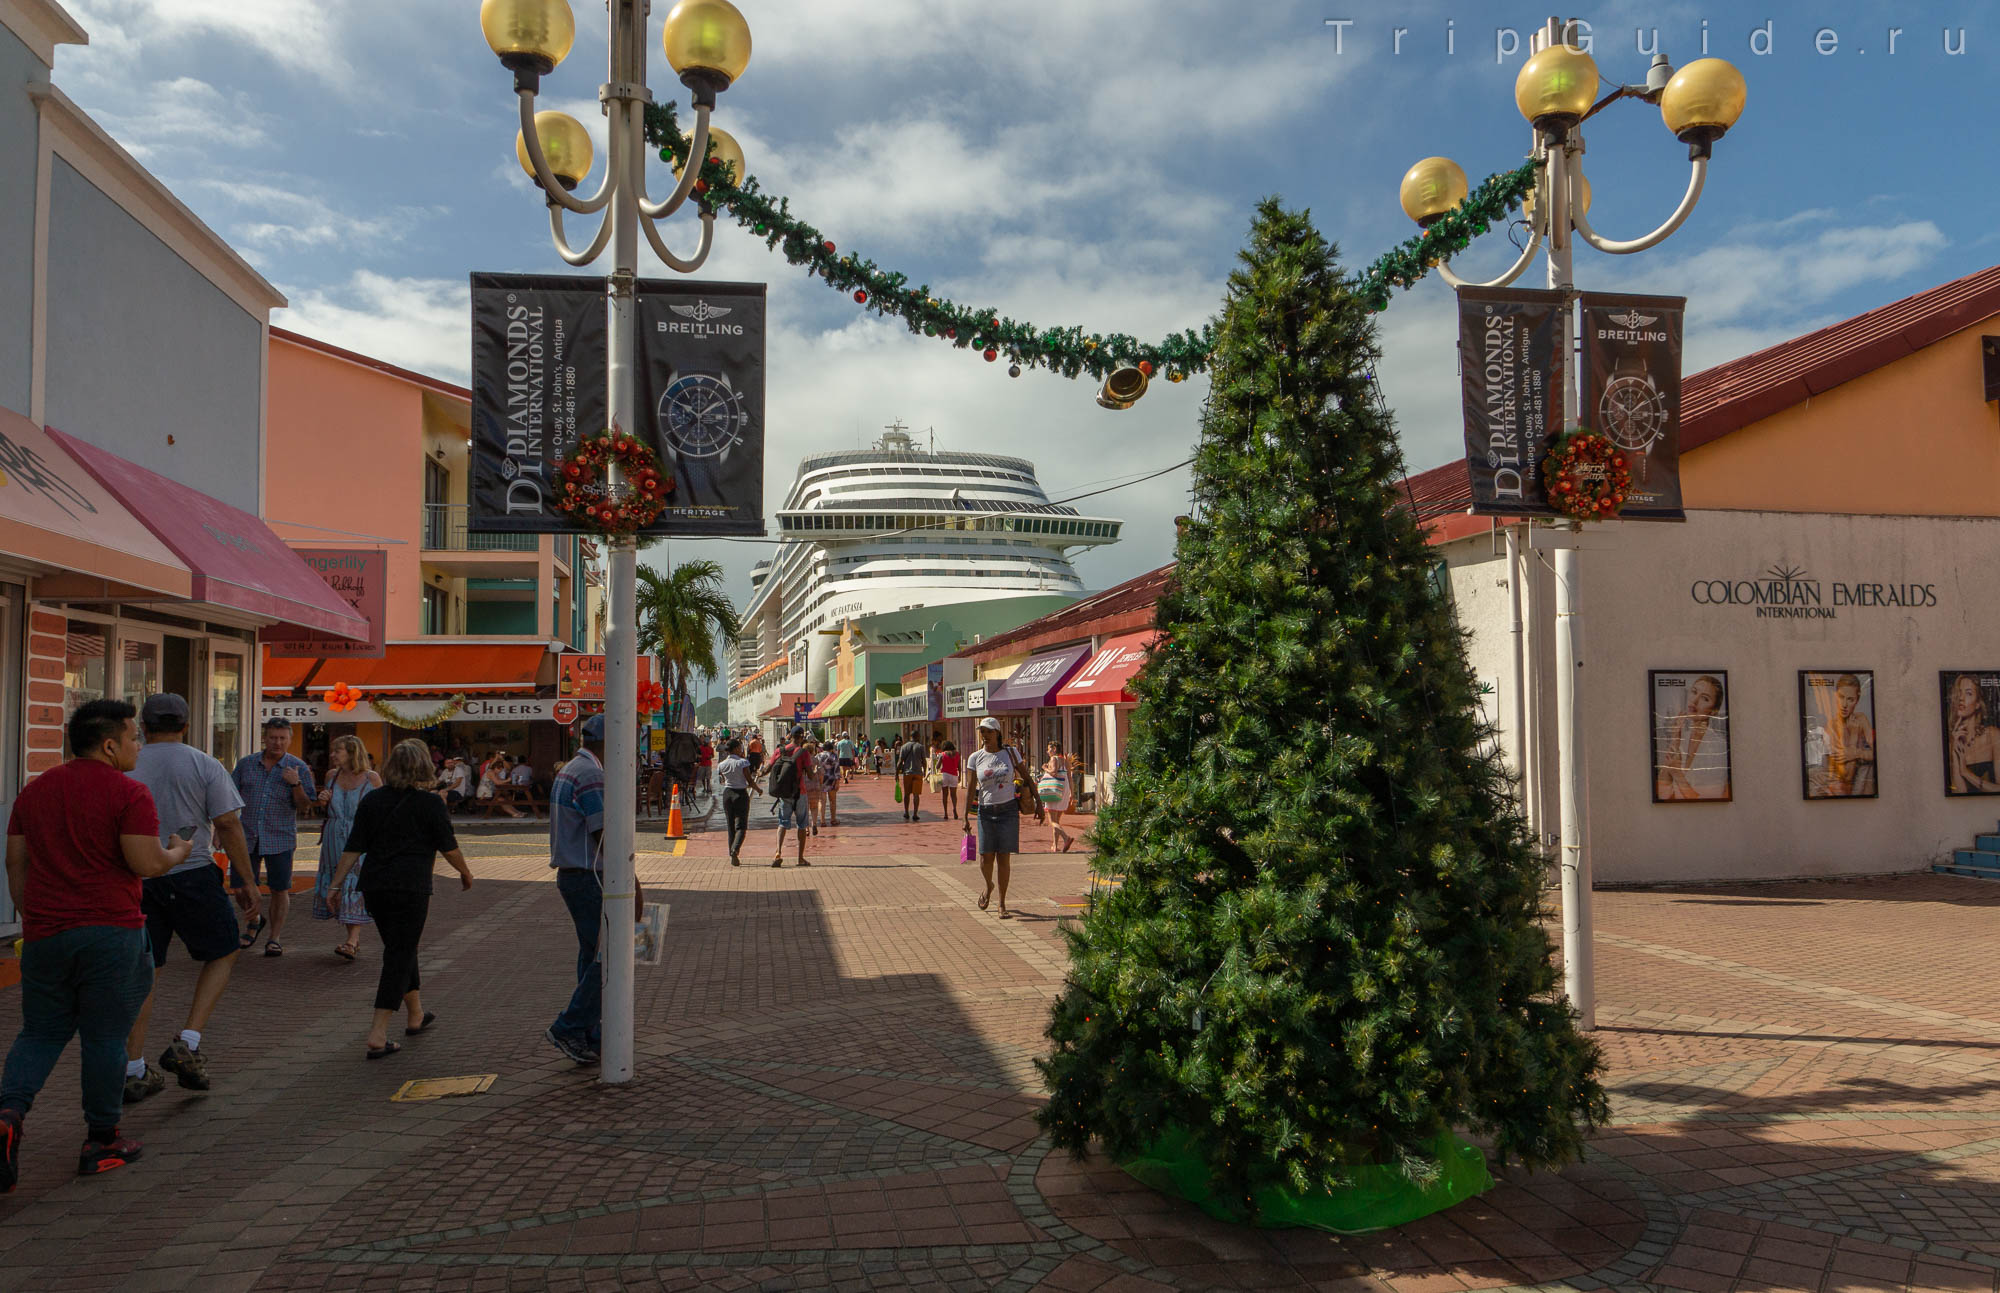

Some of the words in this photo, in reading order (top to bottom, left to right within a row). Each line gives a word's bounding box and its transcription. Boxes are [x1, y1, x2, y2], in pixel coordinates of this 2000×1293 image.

[553, 319, 565, 361] Antigua
[657, 321, 744, 336] BREITLING
[1597, 329, 1667, 342] BREITLING
[1521, 327, 1531, 365] Antigua
[528, 305, 544, 457] INTERNATIONAL
[552, 363, 563, 398] John's,
[1502, 315, 1518, 449] INTERNATIONAL
[1522, 367, 1532, 398] John's,
[552, 400, 562, 413] St.
[566, 366, 576, 444] 1-268-481-1880
[1523, 399, 1532, 411] St.
[1532, 369, 1544, 438] 1-268-481-1880
[552, 417, 563, 446] Quay,
[1524, 413, 1534, 439] Quay,
[1525, 441, 1536, 480] Heritage
[673, 508, 726, 516] HERITAGE
[1691, 580, 1821, 606] COLOMBIAN
[1833, 583, 1938, 608] EMERALDS
[1756, 606, 1837, 620] INTERNATIONAL
[1019, 657, 1066, 678] LIPSTICK
